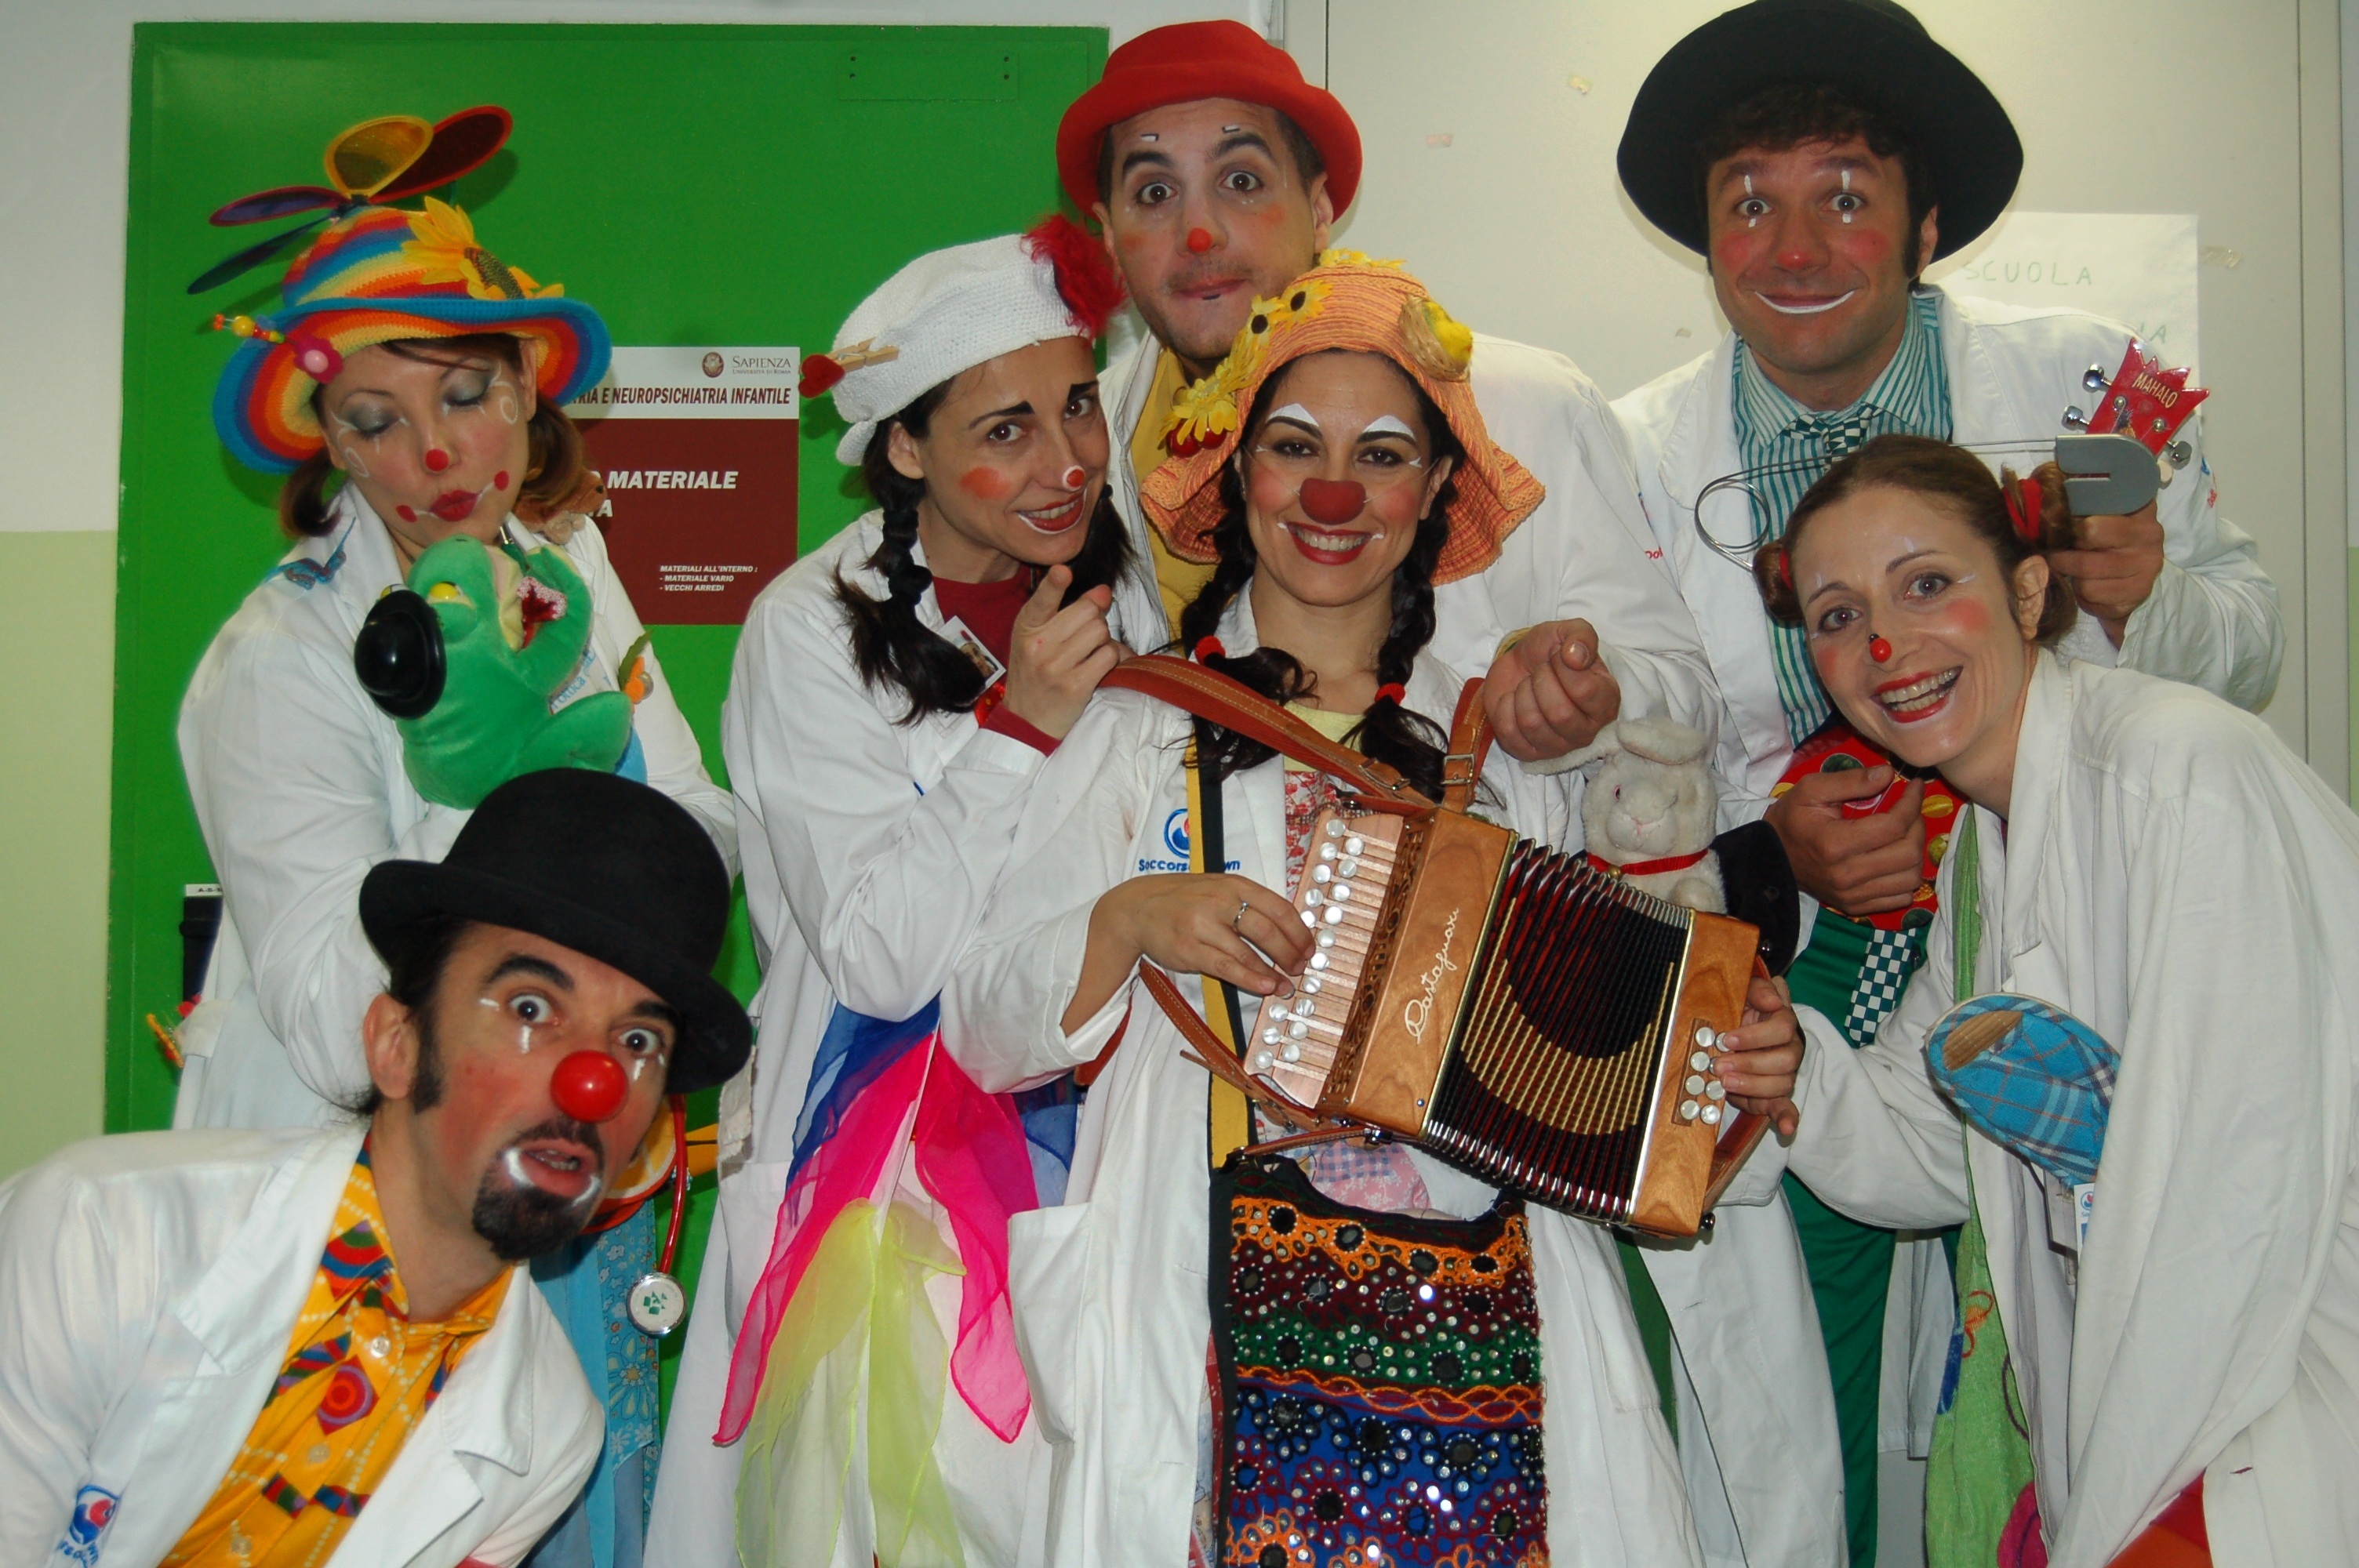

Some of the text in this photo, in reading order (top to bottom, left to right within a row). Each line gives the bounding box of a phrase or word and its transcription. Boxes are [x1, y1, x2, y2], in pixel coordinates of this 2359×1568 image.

[1962, 261, 2092, 286] SCUOLA
[732, 355, 791, 368] SAPIENZA
[602, 387, 610, 404] E
[612, 387, 727, 404] NEUROPSICHIATRIA
[731, 387, 791, 404] INFANTILE
[2132, 372, 2179, 408] MAHALO
[607, 471, 739, 489] MATERIALE
[1139, 858, 1190, 872] Soccors
